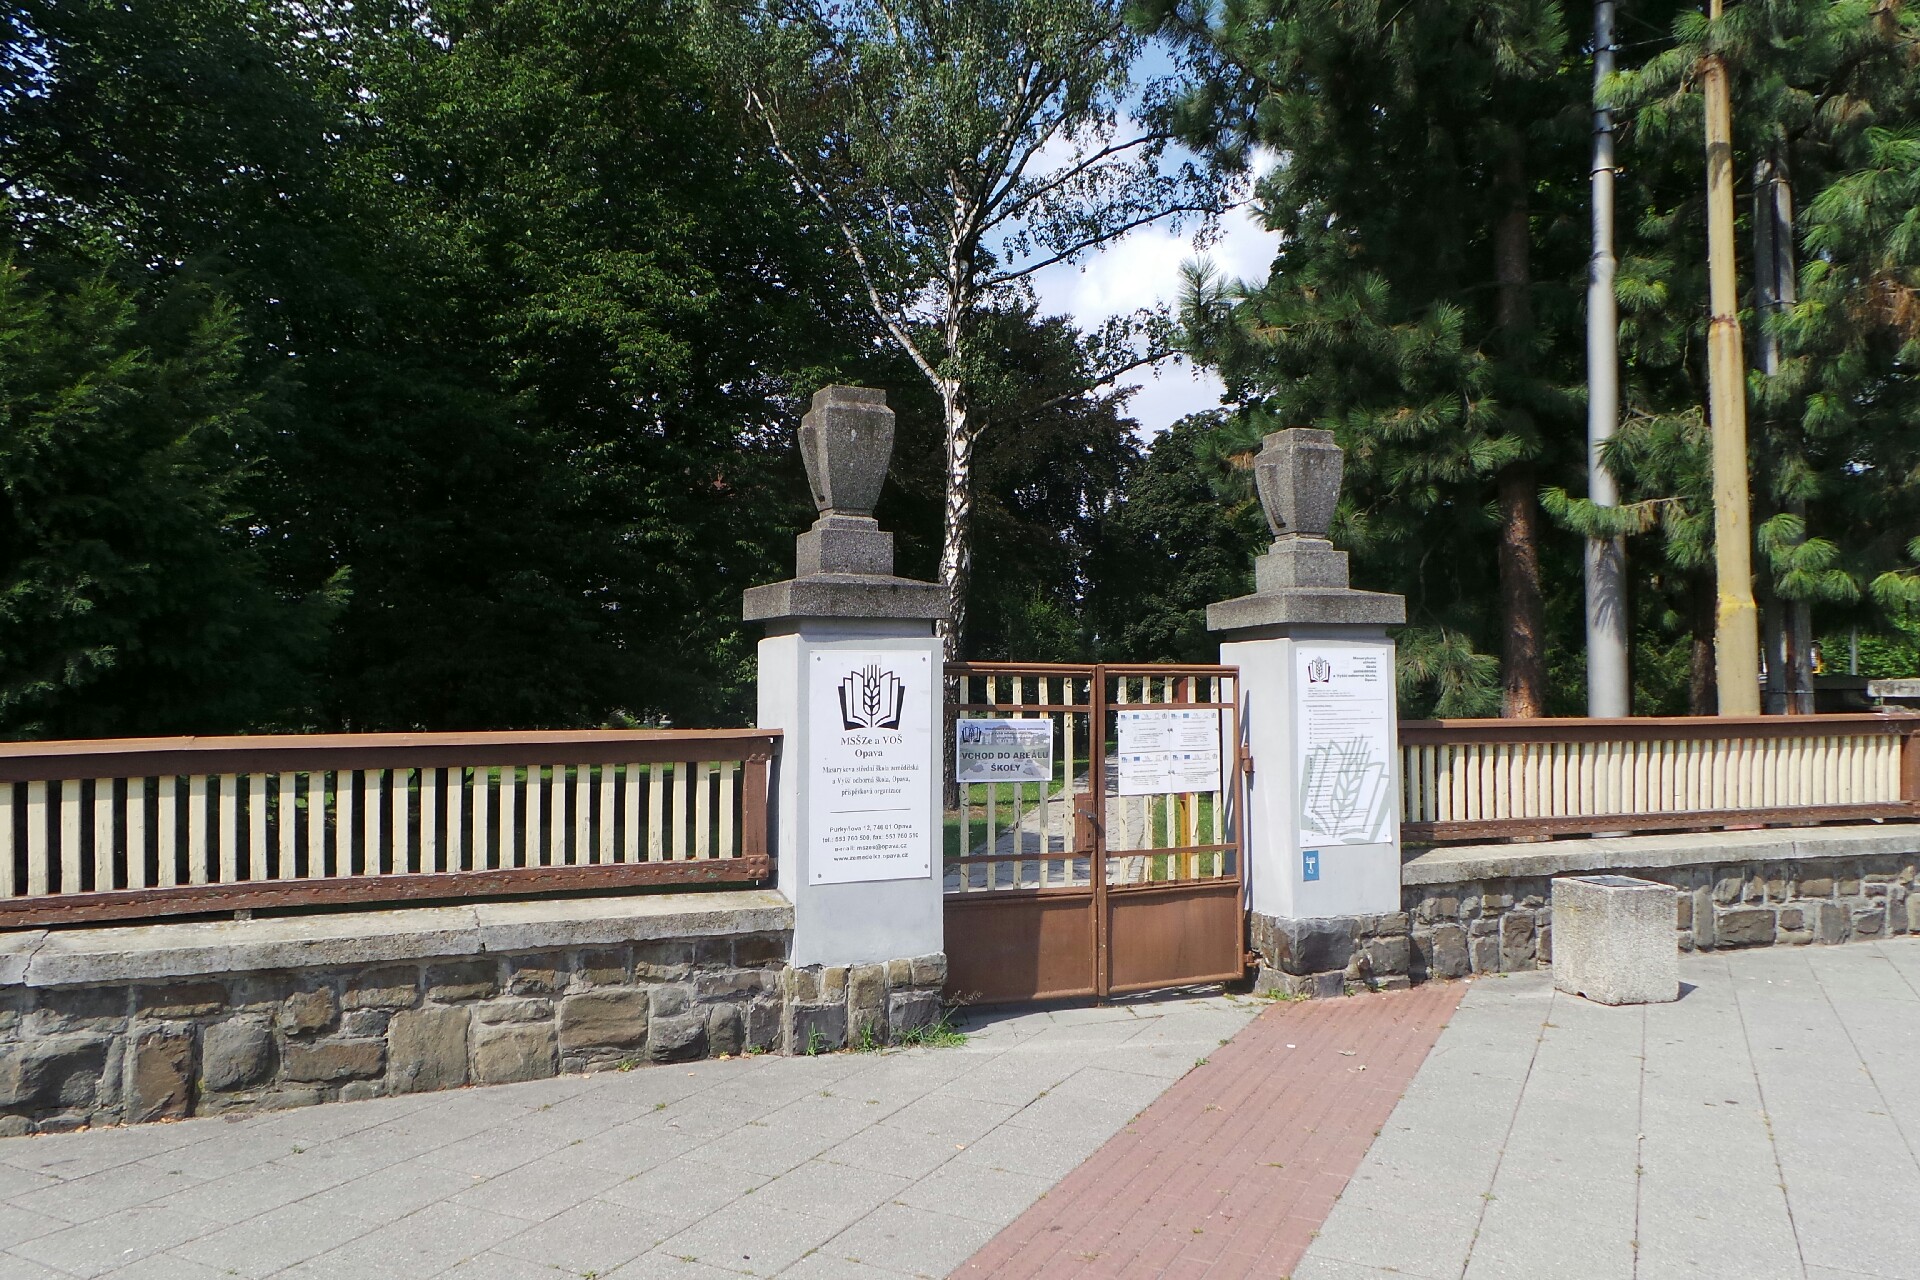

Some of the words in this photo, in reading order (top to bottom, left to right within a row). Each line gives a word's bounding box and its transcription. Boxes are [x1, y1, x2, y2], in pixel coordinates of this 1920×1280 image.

[840, 734, 873, 745] MSŠZe
[882, 733, 903, 745] VOŠ
[854, 749, 883, 759] Opava
[961, 752, 995, 760] VCHOD
[1012, 749, 1049, 759] AREÁLU
[875, 764, 890, 772] škola
[990, 763, 1021, 772] ŠKOLY
